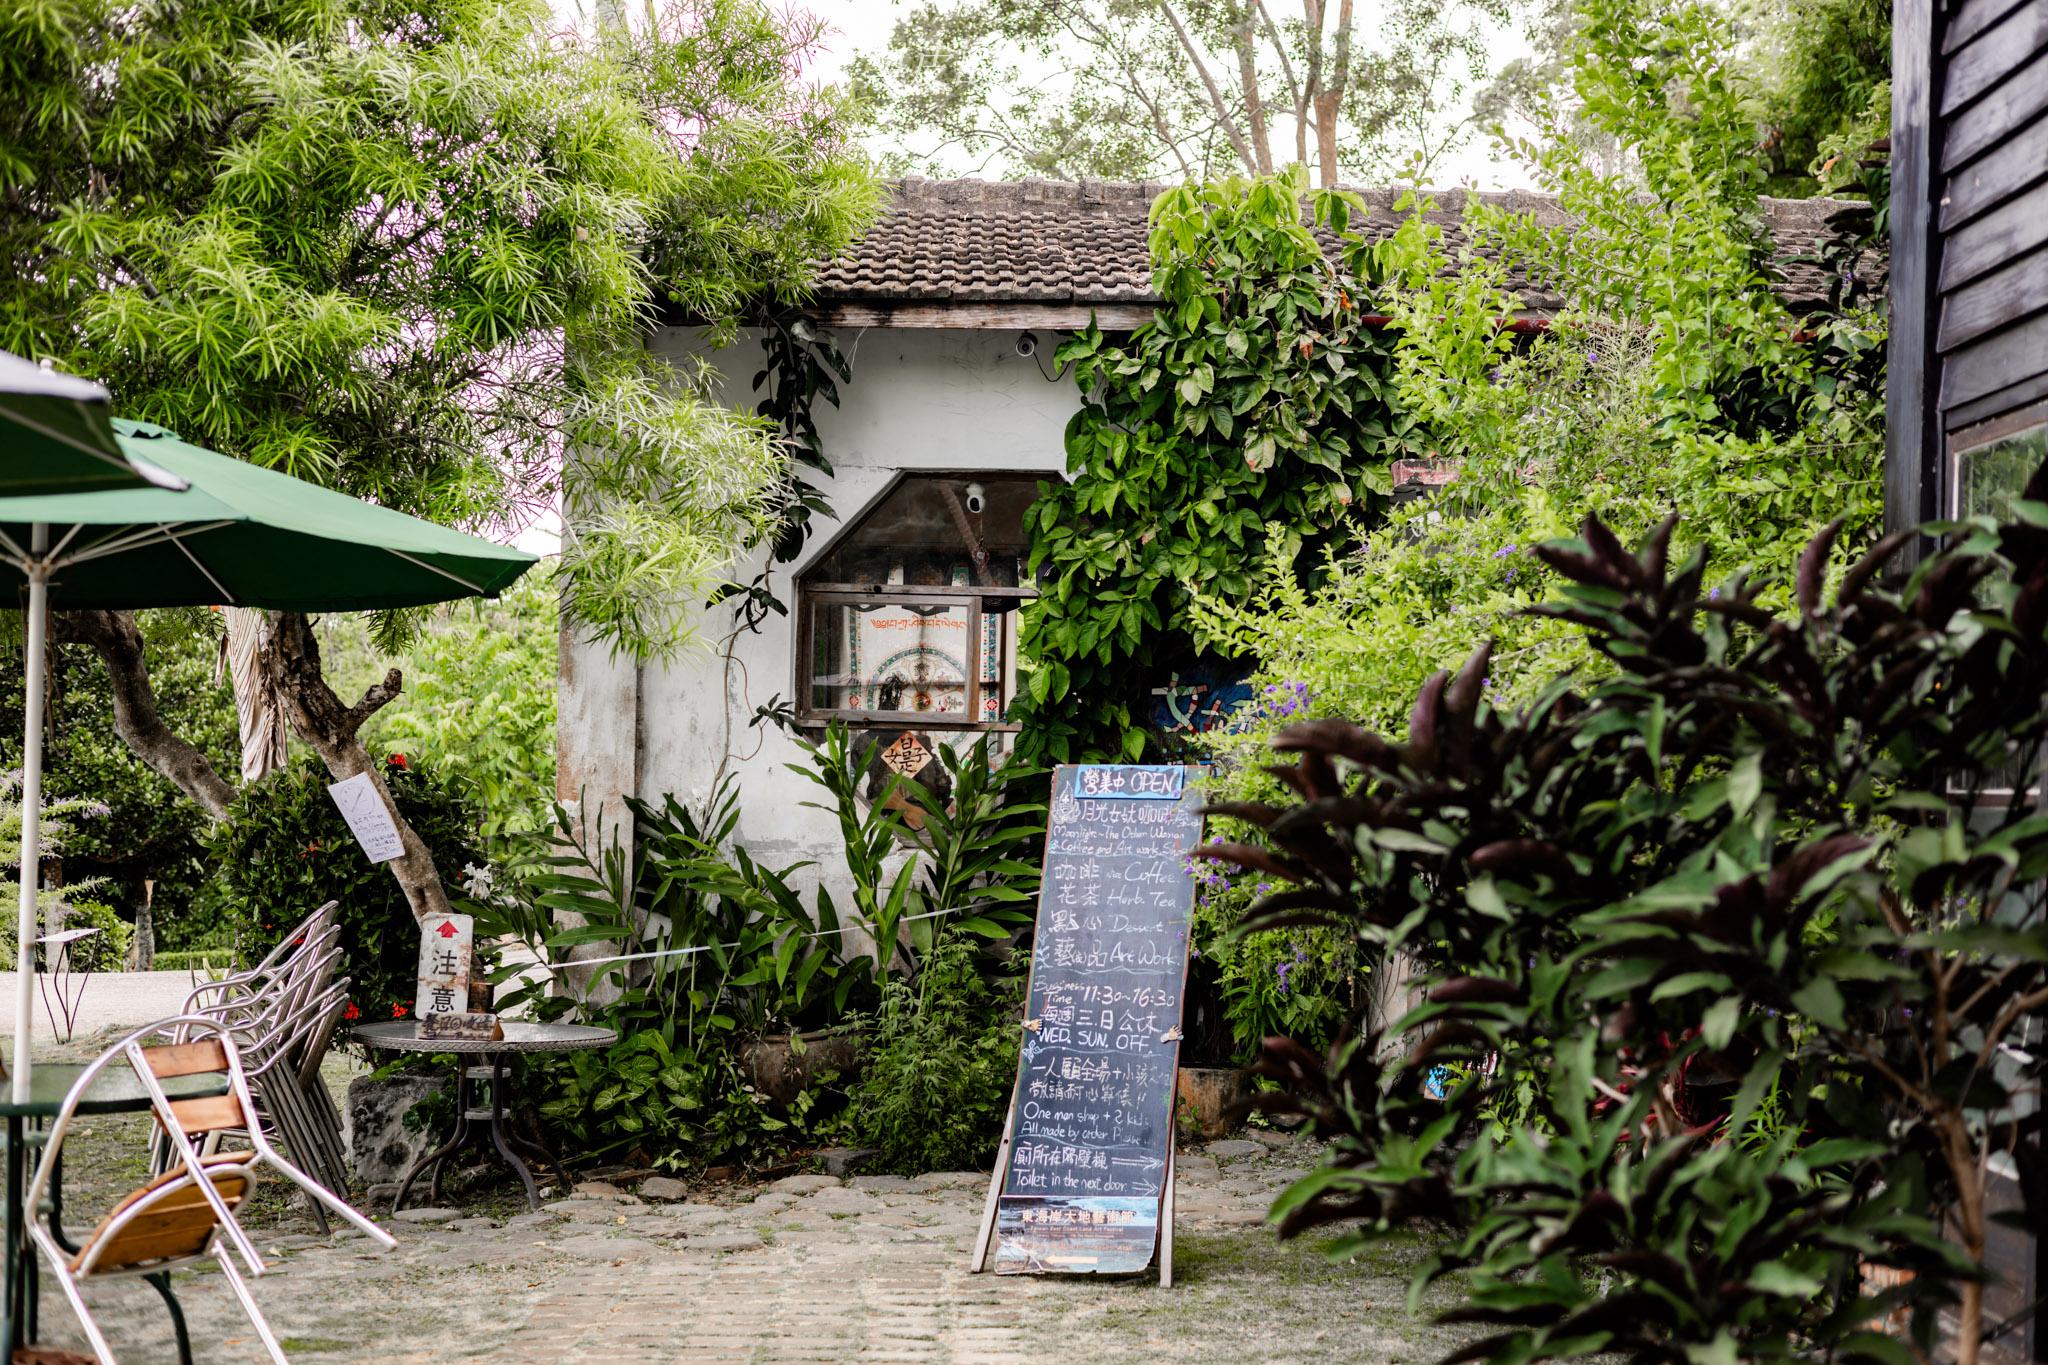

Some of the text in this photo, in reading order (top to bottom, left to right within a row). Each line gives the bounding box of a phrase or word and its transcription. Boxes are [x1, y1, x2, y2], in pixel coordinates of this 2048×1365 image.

[1083, 768, 1126, 795] 營業中
[1131, 771, 1177, 793] OPEN
[1054, 858, 1100, 881] 咖啡
[1057, 883, 1101, 906] 花茶
[1110, 941, 1135, 963] Art
[430, 949, 458, 1012] 注意
[1023, 1101, 1051, 1120] One
[1054, 1110, 1074, 1121] man
[1077, 1107, 1100, 1126] shop
[1021, 1120, 1039, 1134] All
[1041, 1125, 1065, 1137] made
[1068, 1126, 1079, 1140] by
[1013, 1168, 1047, 1188] Toilet
[1051, 1171, 1061, 1186] in
[1063, 1172, 1079, 1187] the
[1081, 1176, 1102, 1191] next
